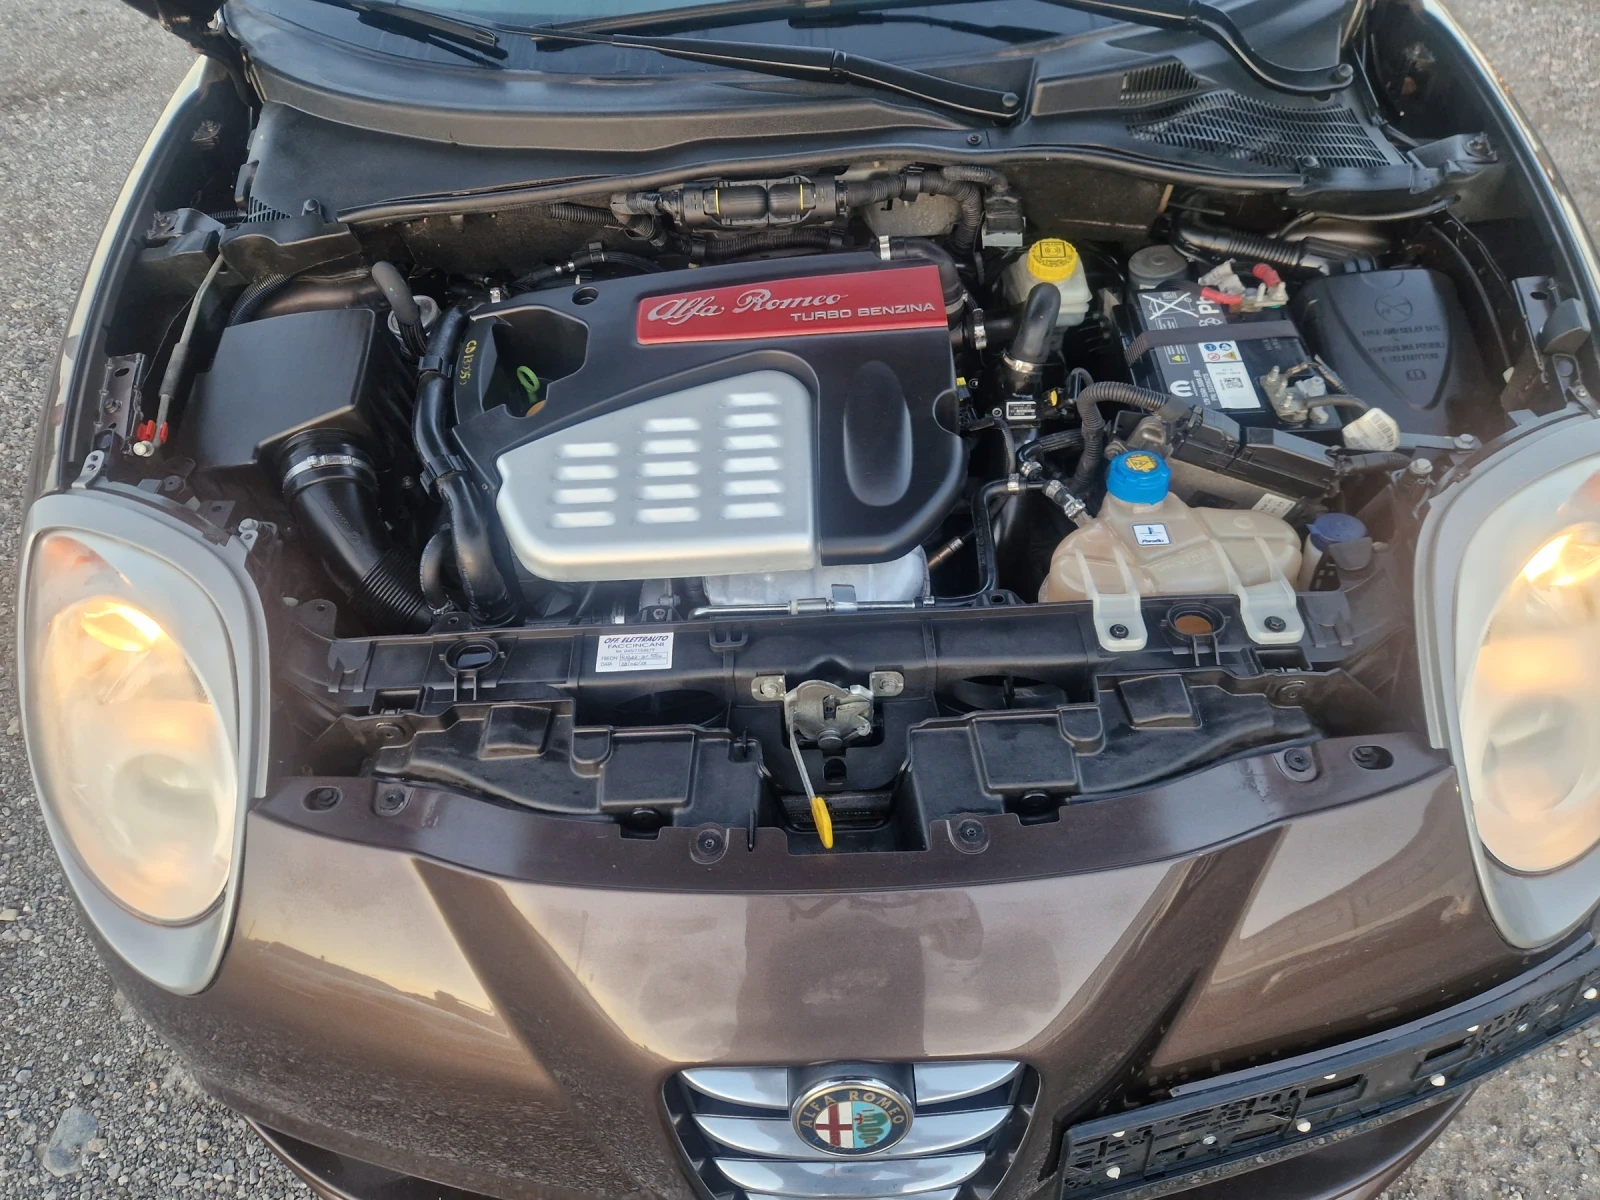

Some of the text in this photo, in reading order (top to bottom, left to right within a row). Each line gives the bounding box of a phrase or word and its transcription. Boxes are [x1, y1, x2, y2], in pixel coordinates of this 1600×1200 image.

[648, 289, 848, 325] Alfa Romeo
[791, 302, 936, 322] TURBO BENZINA
[621, 635, 669, 643] ELETTRAUTO
[801, 1090, 905, 1128] ALFA ROMEO
